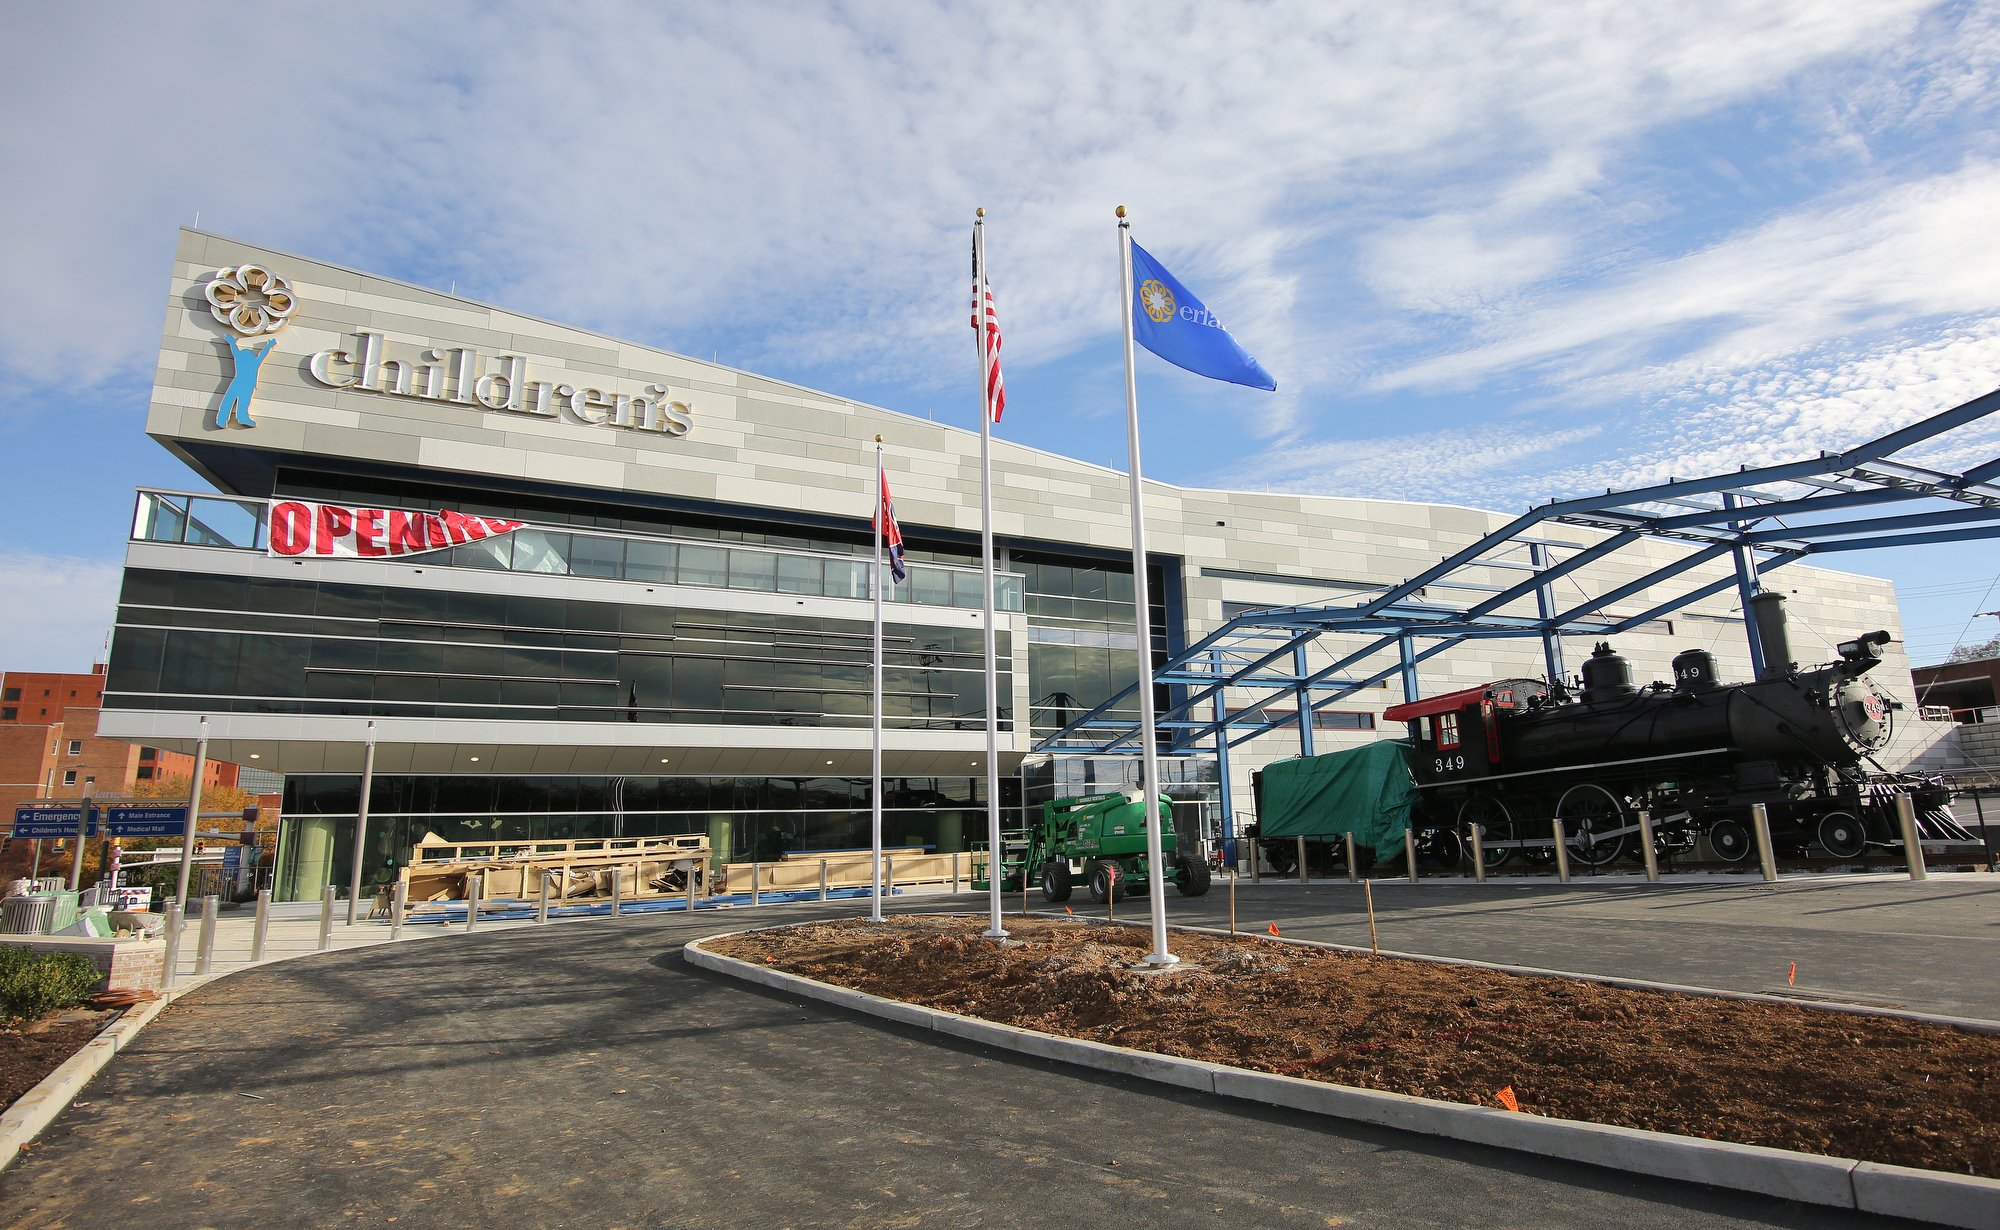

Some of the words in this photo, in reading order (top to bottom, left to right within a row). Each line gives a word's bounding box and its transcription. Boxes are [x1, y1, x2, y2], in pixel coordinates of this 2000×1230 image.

[1180, 303, 1226, 331] erla
[309, 332, 694, 436] children's
[1674, 667, 1700, 681] 349
[1435, 755, 1465, 773] 349
[33, 812, 81, 823] Emergency
